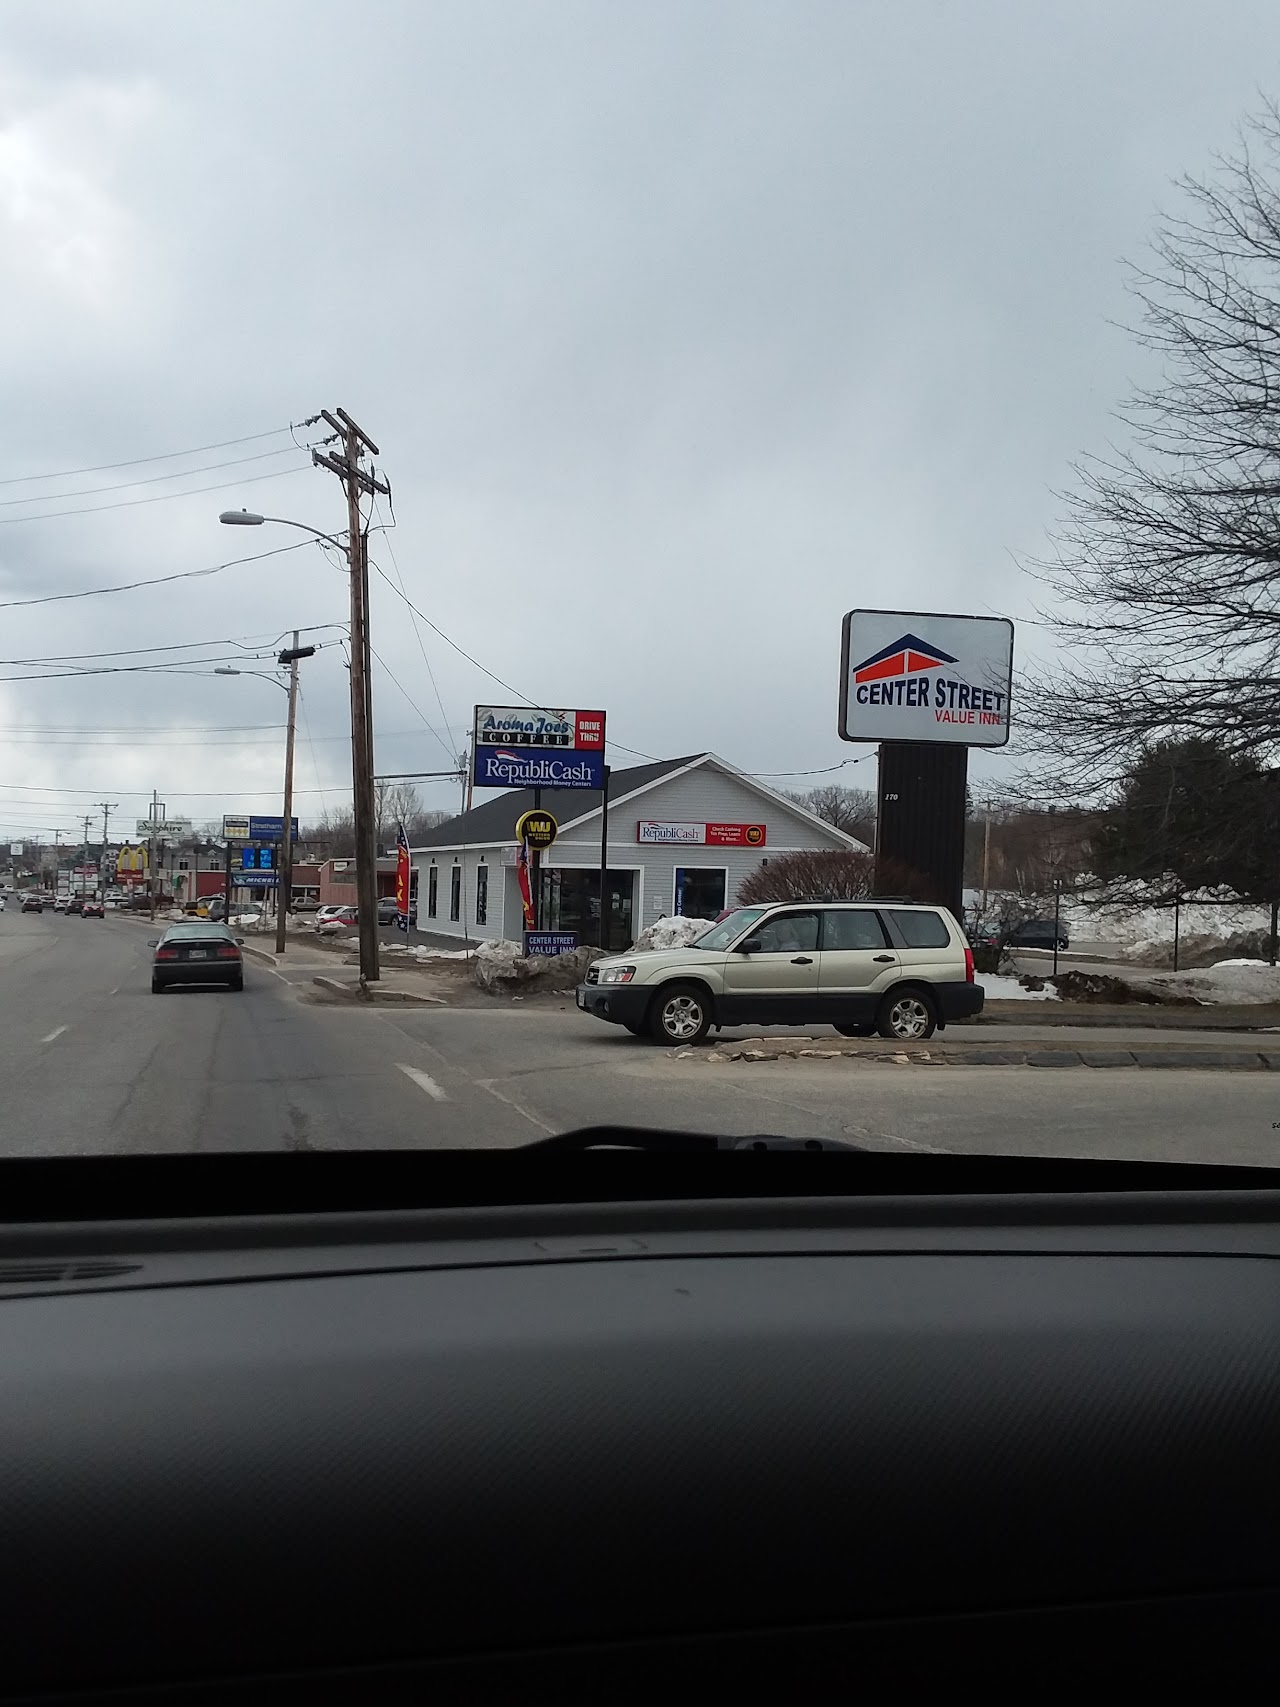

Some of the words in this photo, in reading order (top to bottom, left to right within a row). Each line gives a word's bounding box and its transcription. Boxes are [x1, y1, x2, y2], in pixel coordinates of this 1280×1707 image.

[856, 677, 930, 707] CENTER
[935, 678, 1006, 711] STREET
[935, 709, 975, 724] VALUE
[979, 711, 1001, 725] INN
[483, 715, 534, 732] Aroma
[579, 720, 601, 731] DRIVE
[488, 733, 563, 745] COFFEE
[579, 732, 599, 742] THRU
[485, 758, 593, 784] RepubliCash
[514, 778, 553, 786] Neighborhood
[553, 779, 571, 787] Money
[884, 793, 899, 801] 170
[642, 827, 700, 841] RepubliCash
[528, 936, 552, 945] CENTER
[552, 936, 575, 945] STREET
[528, 945, 557, 954] VALUE
